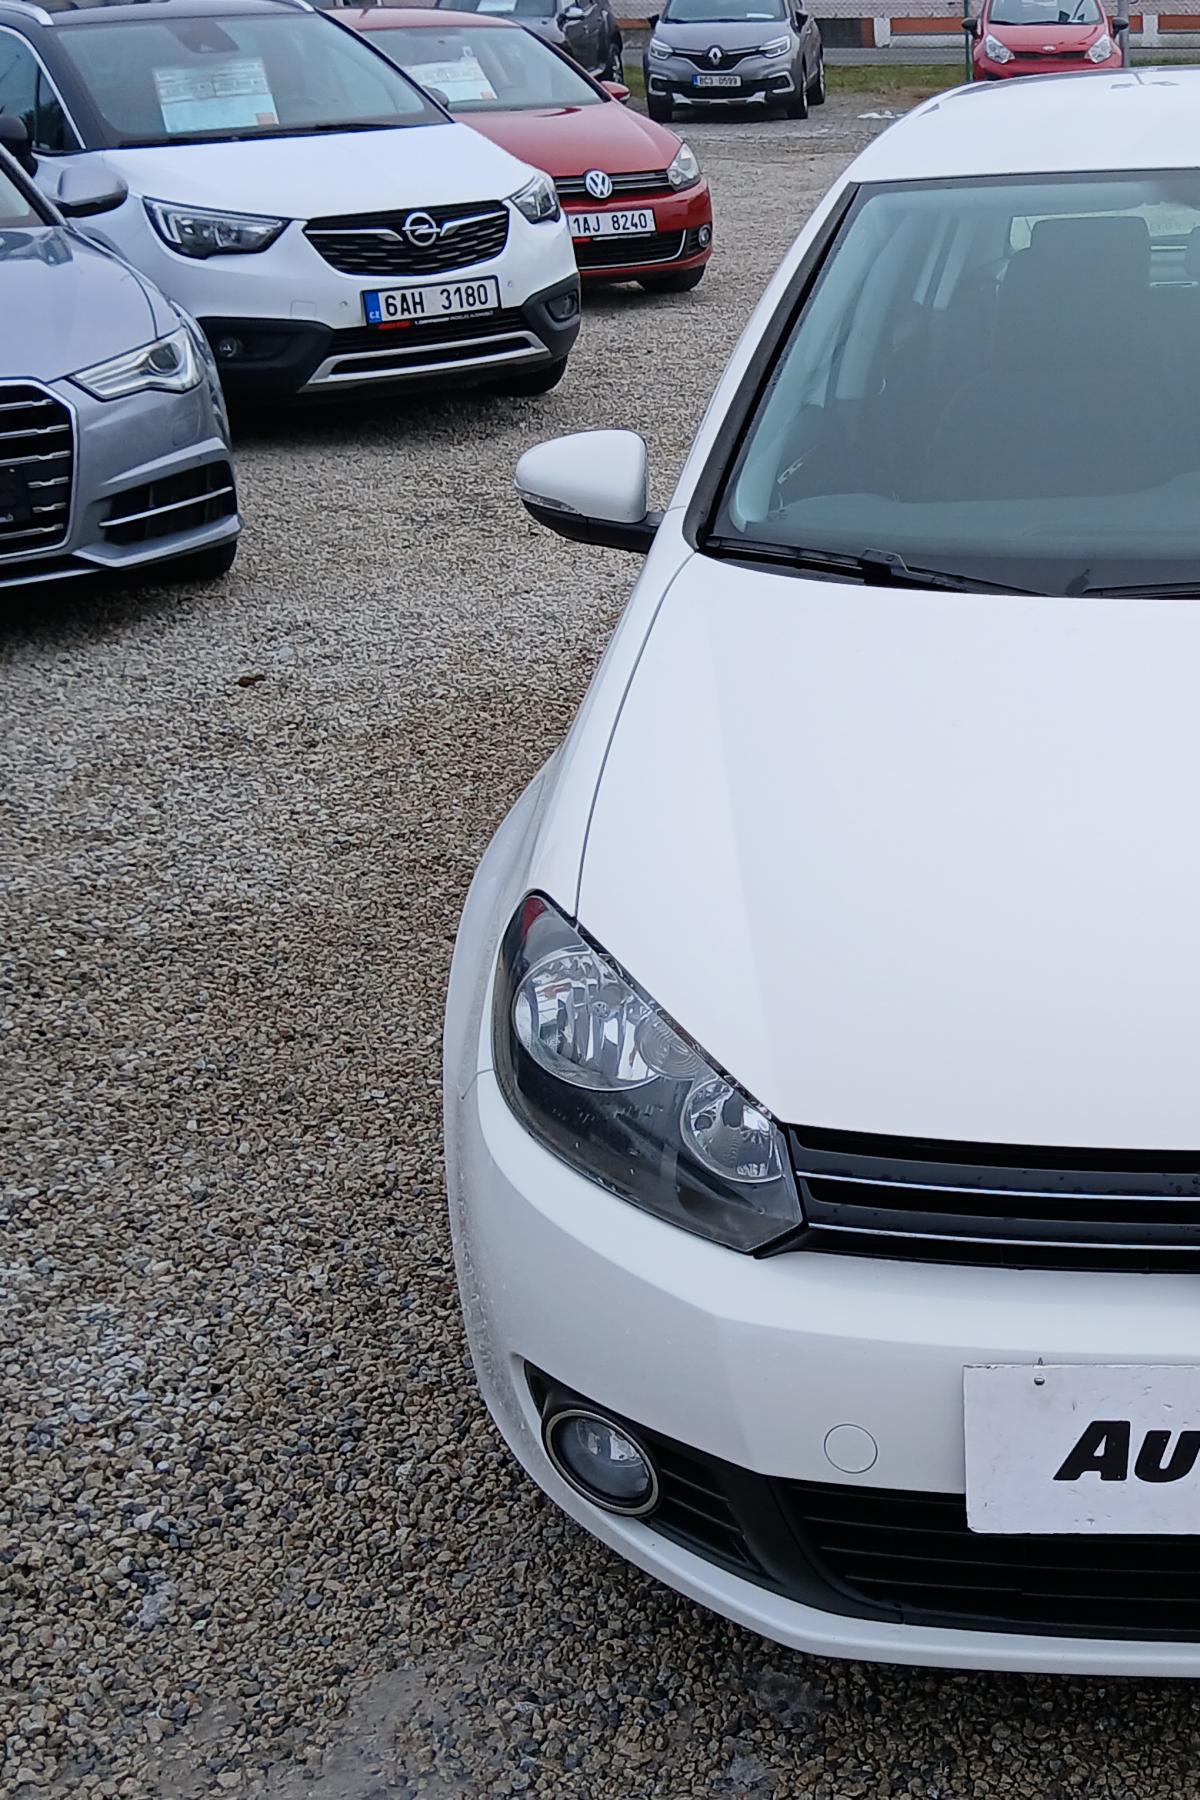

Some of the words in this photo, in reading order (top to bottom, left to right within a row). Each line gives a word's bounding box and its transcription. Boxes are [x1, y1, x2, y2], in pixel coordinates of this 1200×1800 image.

[573, 215, 601, 234] 1AJ
[611, 212, 648, 231] 8240
[384, 291, 425, 316] 6AH
[440, 284, 489, 310] 3180
